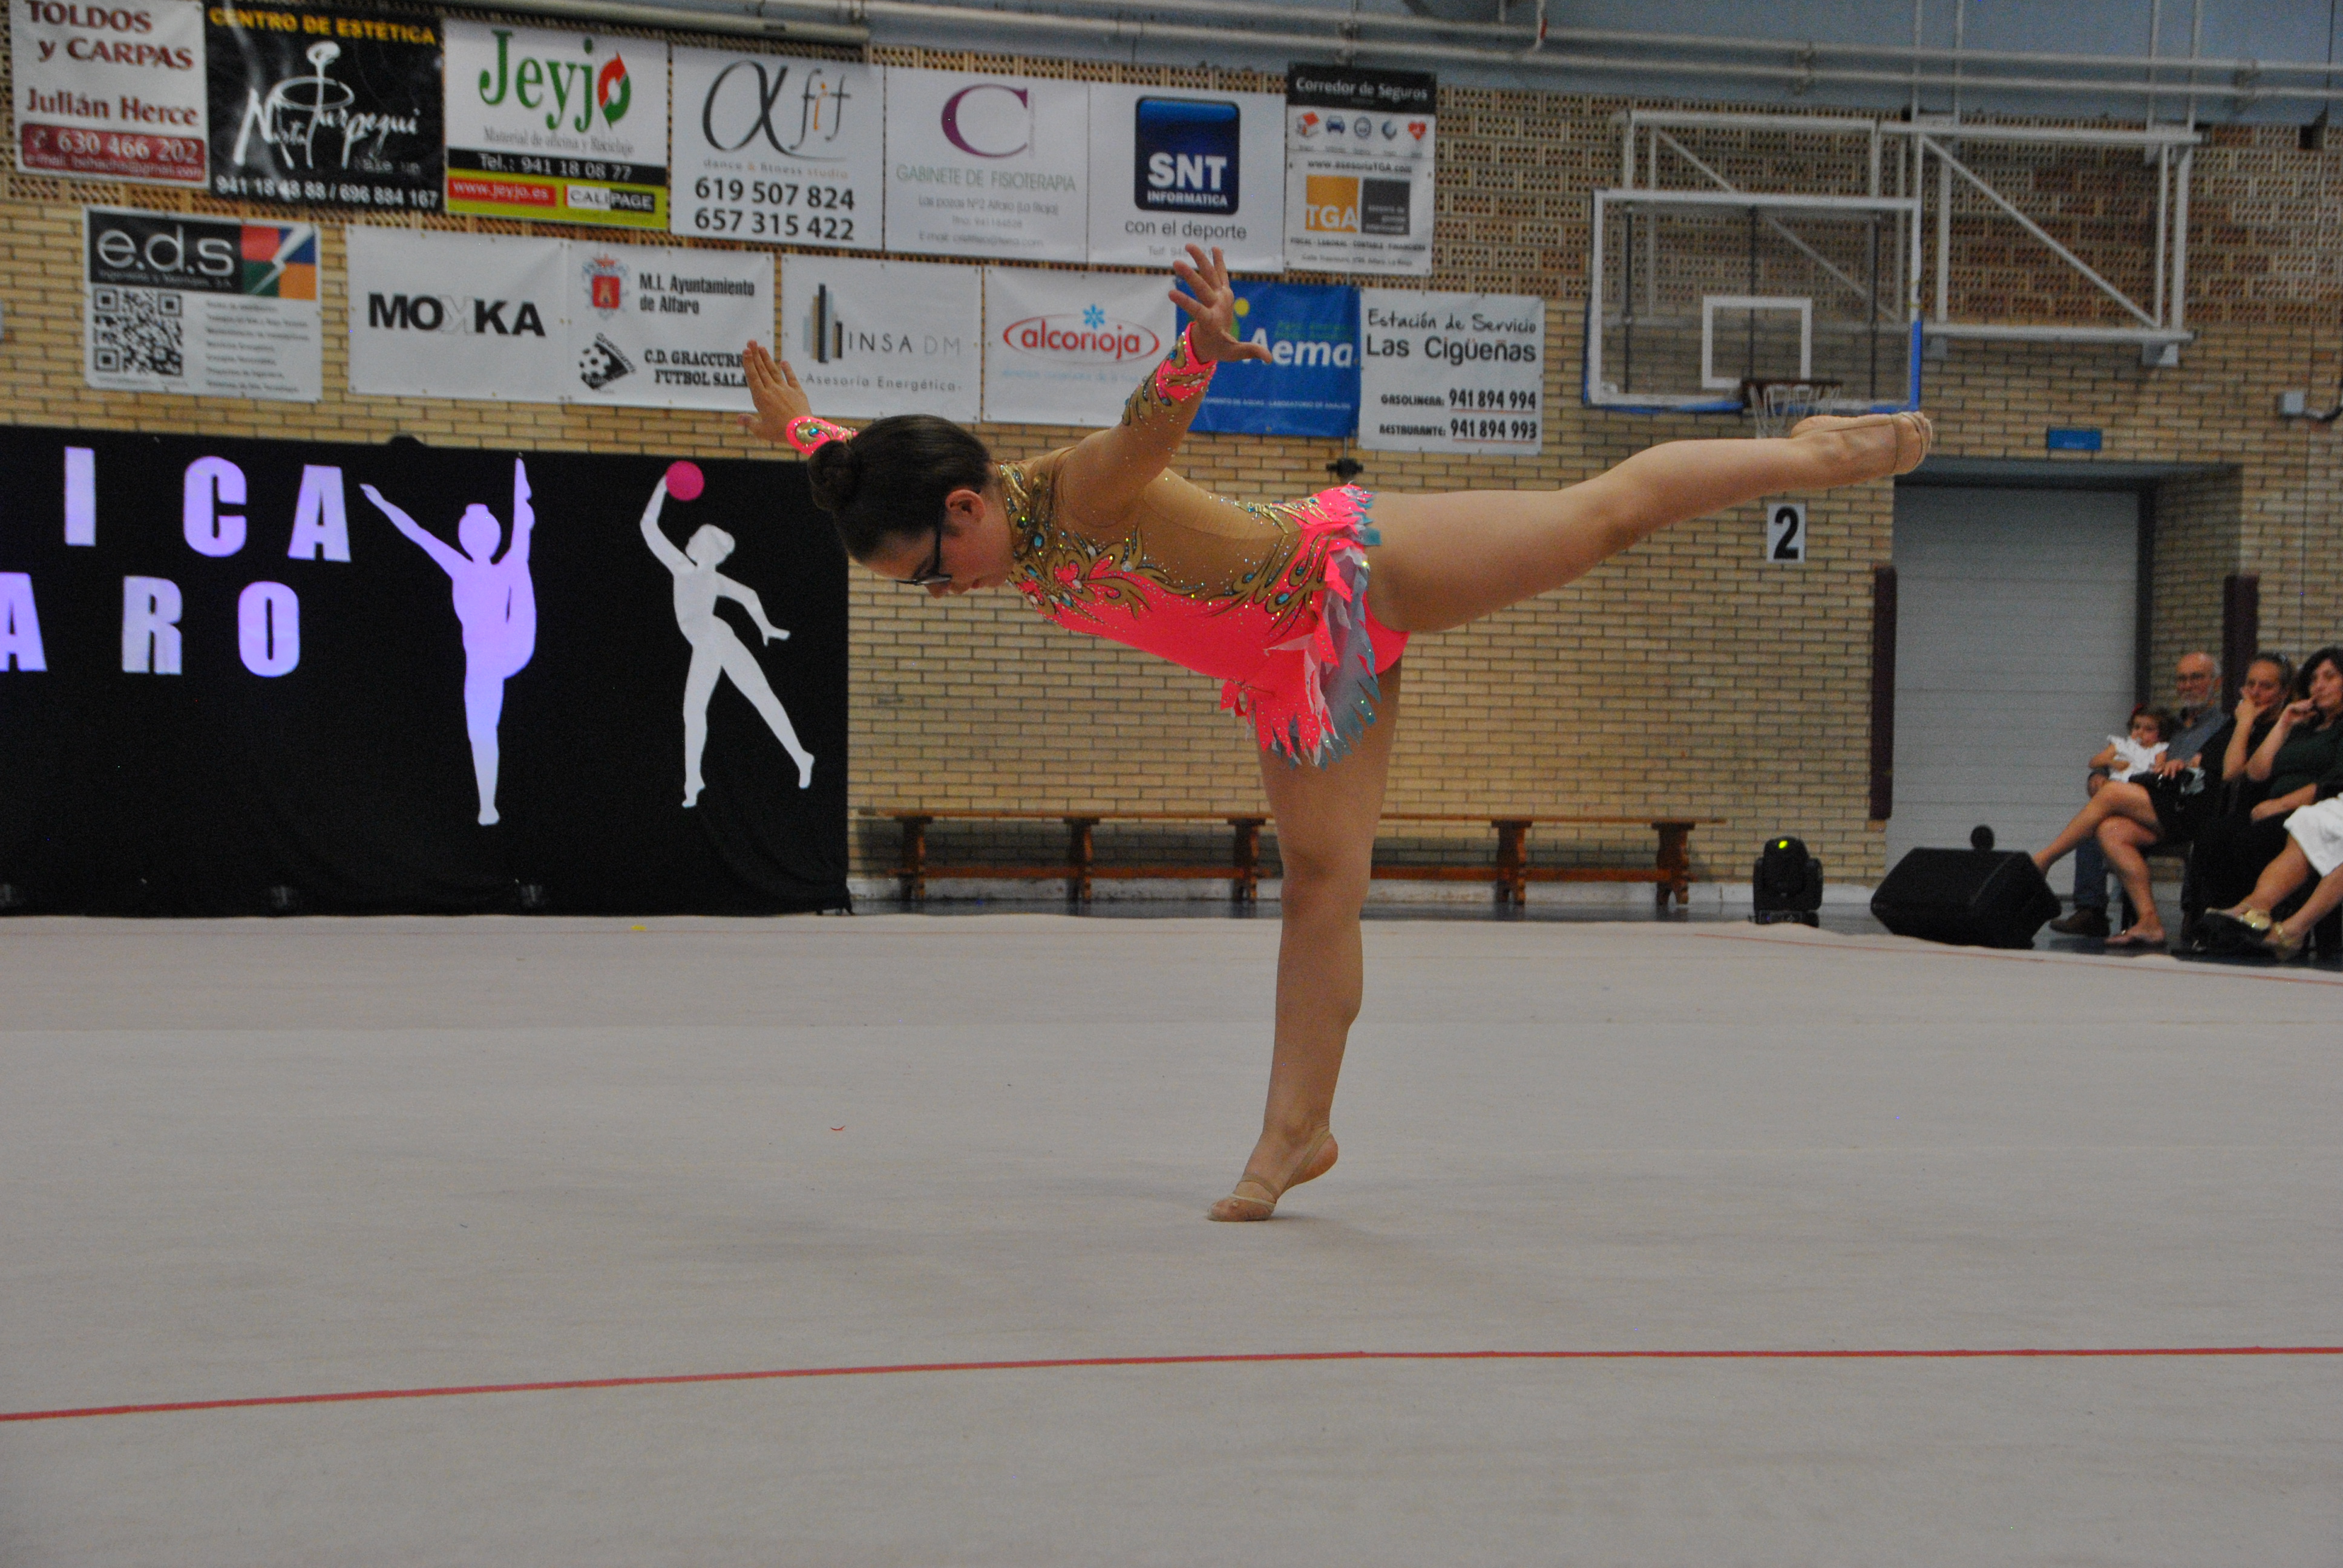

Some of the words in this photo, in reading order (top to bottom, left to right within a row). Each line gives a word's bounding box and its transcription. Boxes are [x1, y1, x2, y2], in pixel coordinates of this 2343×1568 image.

[26, 0, 152, 33] TOLDOS
[209, 7, 298, 32] CENTRO
[303, 15, 332, 35] DE
[38, 39, 56, 62] y
[67, 37, 194, 70] CARPAS
[1296, 76, 1355, 95] Corredor
[1359, 80, 1374, 96] de
[1378, 83, 1427, 103] Seguros
[28, 88, 110, 119] Julián
[120, 96, 198, 126] Herce
[941, 83, 1027, 158] C
[57, 129, 100, 155] 630
[108, 136, 150, 159] 466
[157, 139, 198, 165] 202
[521, 157, 551, 175] 941
[560, 160, 579, 177] 18
[585, 163, 606, 180] 08
[611, 165, 632, 181] 77
[896, 163, 960, 185] GABINETE
[966, 168, 983, 188] DE
[991, 170, 1076, 191] FISIOTERAPIA
[1148, 152, 1227, 191] SNT
[409, 188, 439, 208] 167
[453, 179, 549, 201] www.jeyjo.es
[695, 177, 744, 201] 619
[752, 180, 799, 206] 507
[807, 185, 854, 210] 824
[695, 207, 743, 232] 657
[752, 211, 799, 236] 315
[807, 215, 854, 240] 422
[1306, 204, 1357, 229] TGA
[1126, 220, 1155, 235] con
[1162, 220, 1176, 235] el
[1182, 220, 1247, 241] deporte
[640, 272, 664, 291] M.I.
[670, 273, 755, 296] Ayuntamiento
[640, 295, 655, 311] de
[659, 295, 699, 315] Alfaro
[1369, 308, 1436, 328] Estación
[1445, 313, 1464, 331] de
[1472, 313, 1536, 333] Servicio
[848, 331, 913, 353] INSA
[925, 335, 960, 355] DM
[1020, 317, 1141, 359] alcorioja
[1242, 328, 1353, 367] Aema
[1366, 333, 1410, 357] Las
[1424, 335, 1536, 366] Cigüeñas
[644, 349, 667, 365] C.D.
[655, 368, 710, 386] FUTBOL
[1449, 388, 1473, 407] 941
[1478, 390, 1504, 409] 894
[1509, 390, 1536, 410] 994
[1450, 418, 1475, 438] 941
[1479, 419, 1506, 439] 894
[1511, 419, 1537, 440] 993
[1773, 506, 1799, 559] 2
